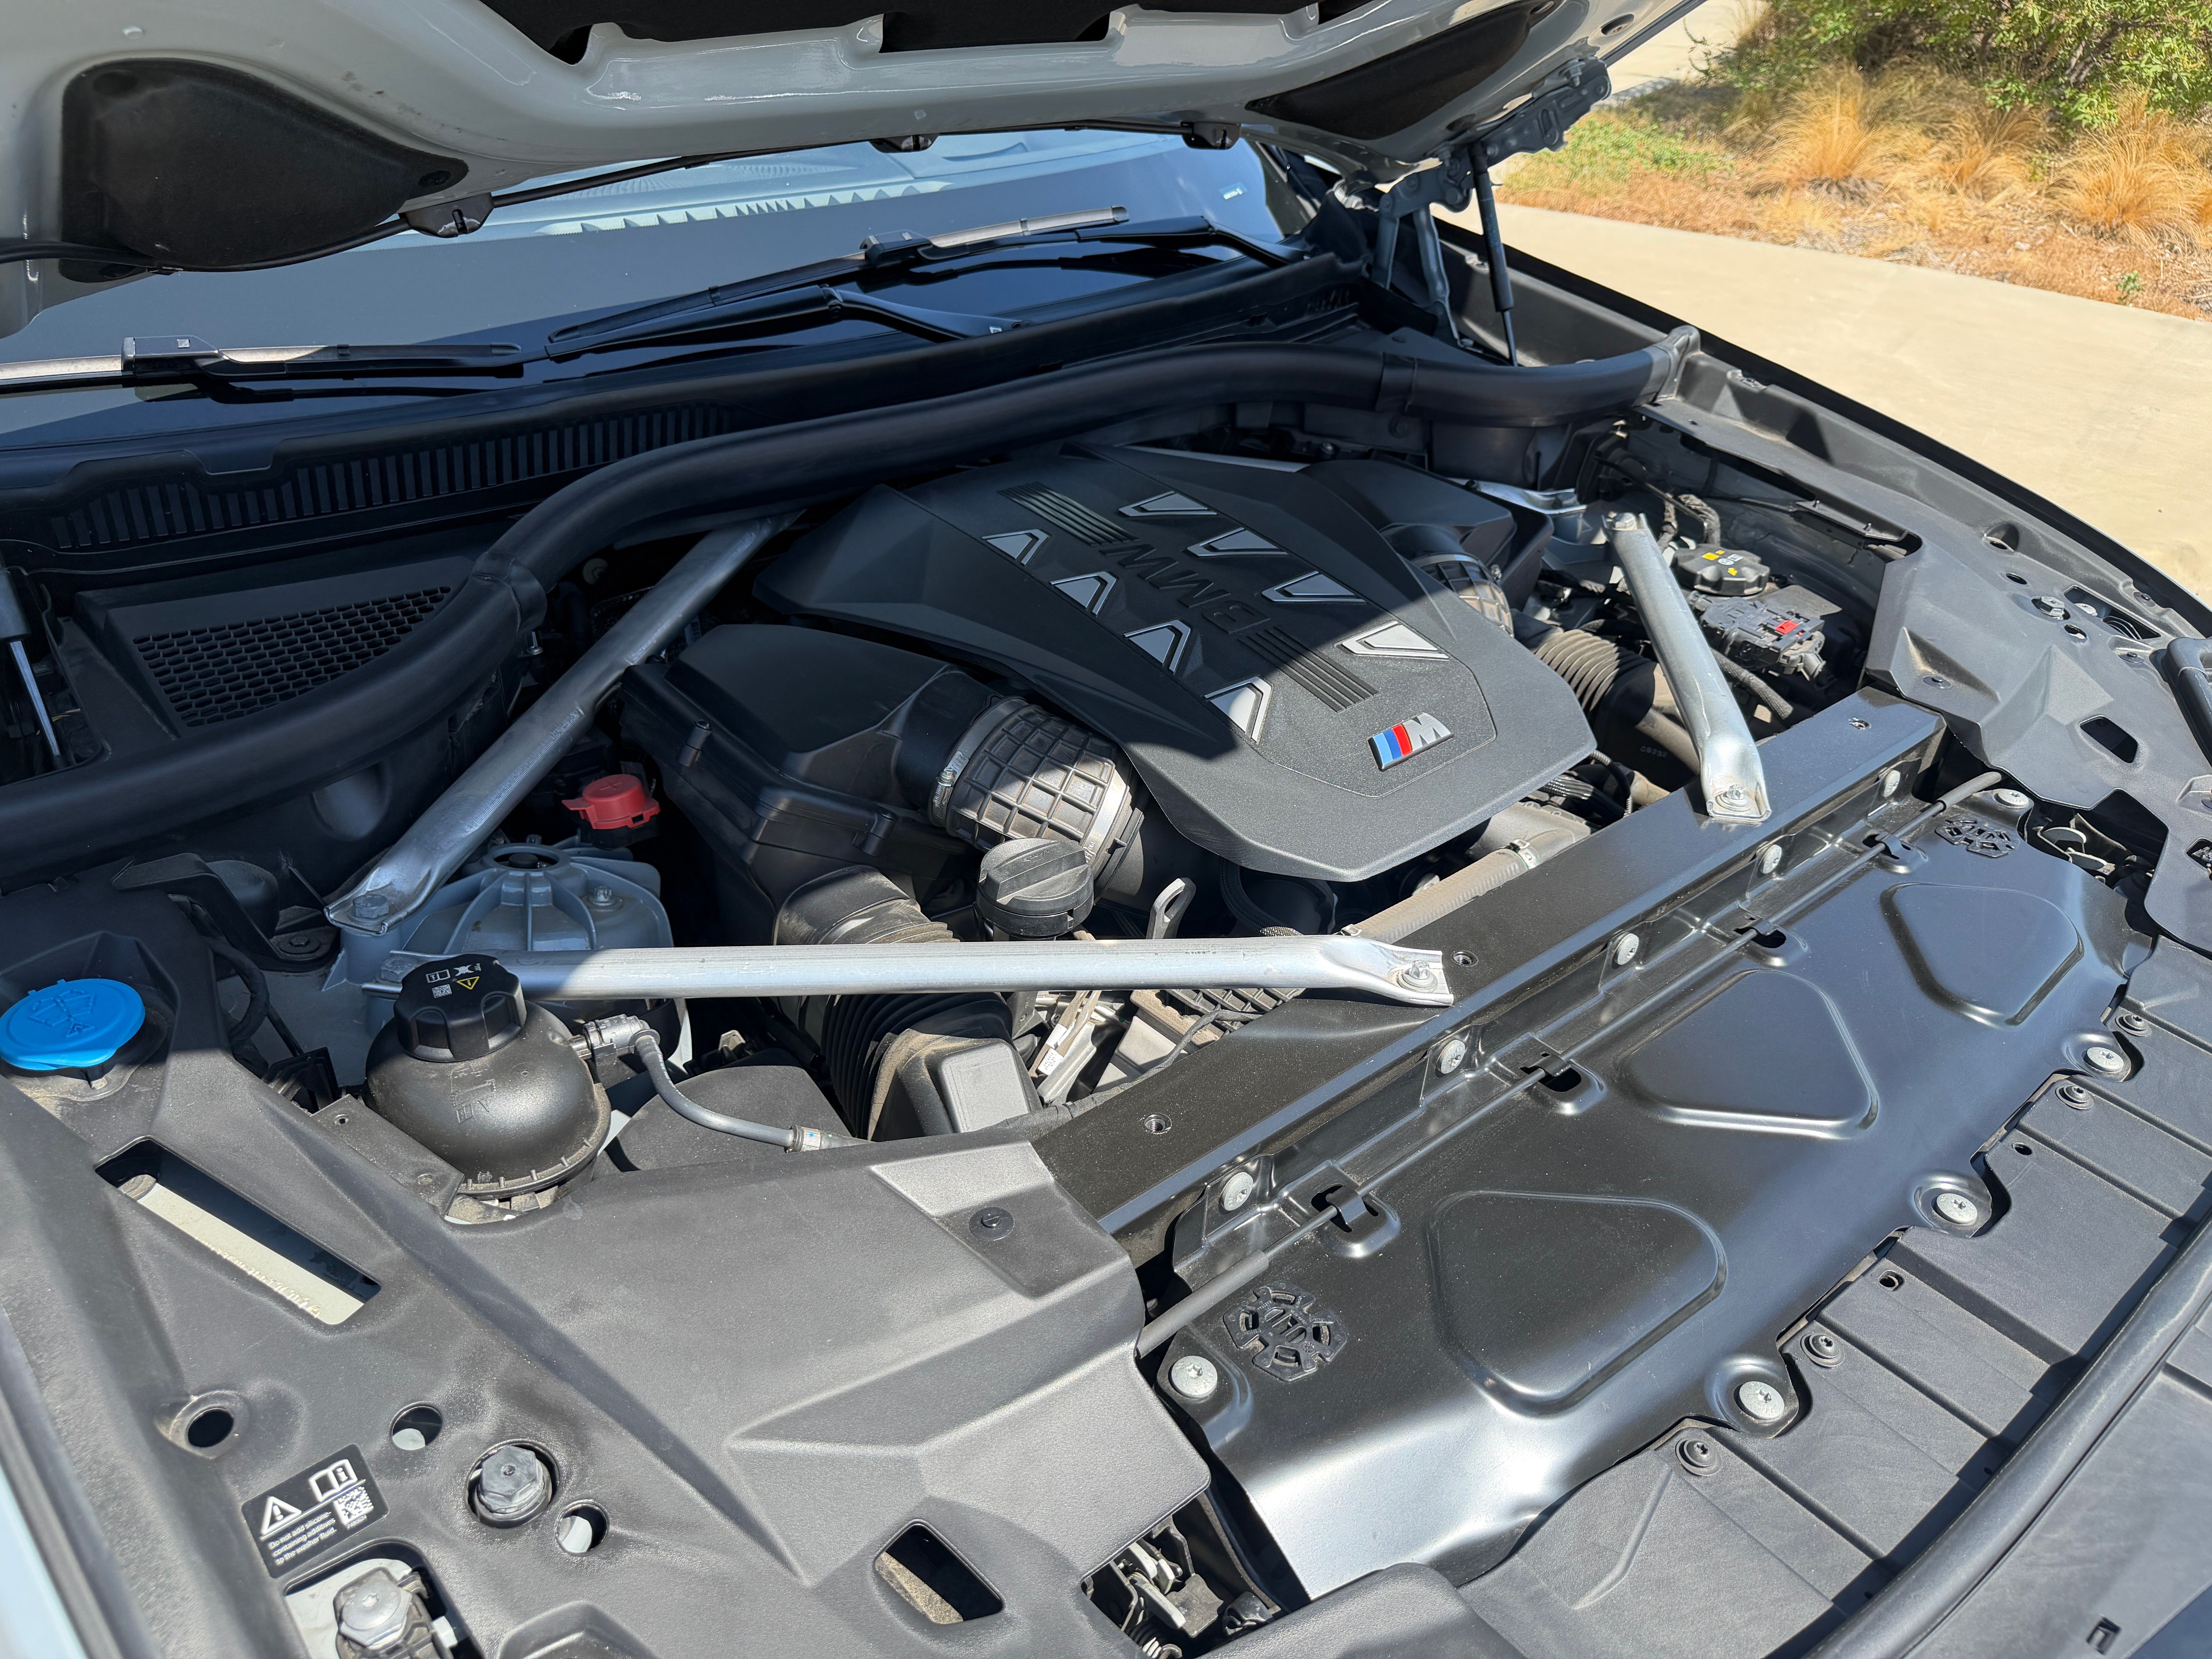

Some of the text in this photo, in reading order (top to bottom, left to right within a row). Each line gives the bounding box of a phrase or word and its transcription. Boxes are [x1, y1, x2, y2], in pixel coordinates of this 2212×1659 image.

[1099, 543, 1271, 634] BMW
[1402, 713, 1451, 751] M
[269, 1511, 332, 1549] Do not add silicone-
[272, 1518, 336, 1556] containing additives
[275, 1527, 337, 1566] to the washer fluid.
